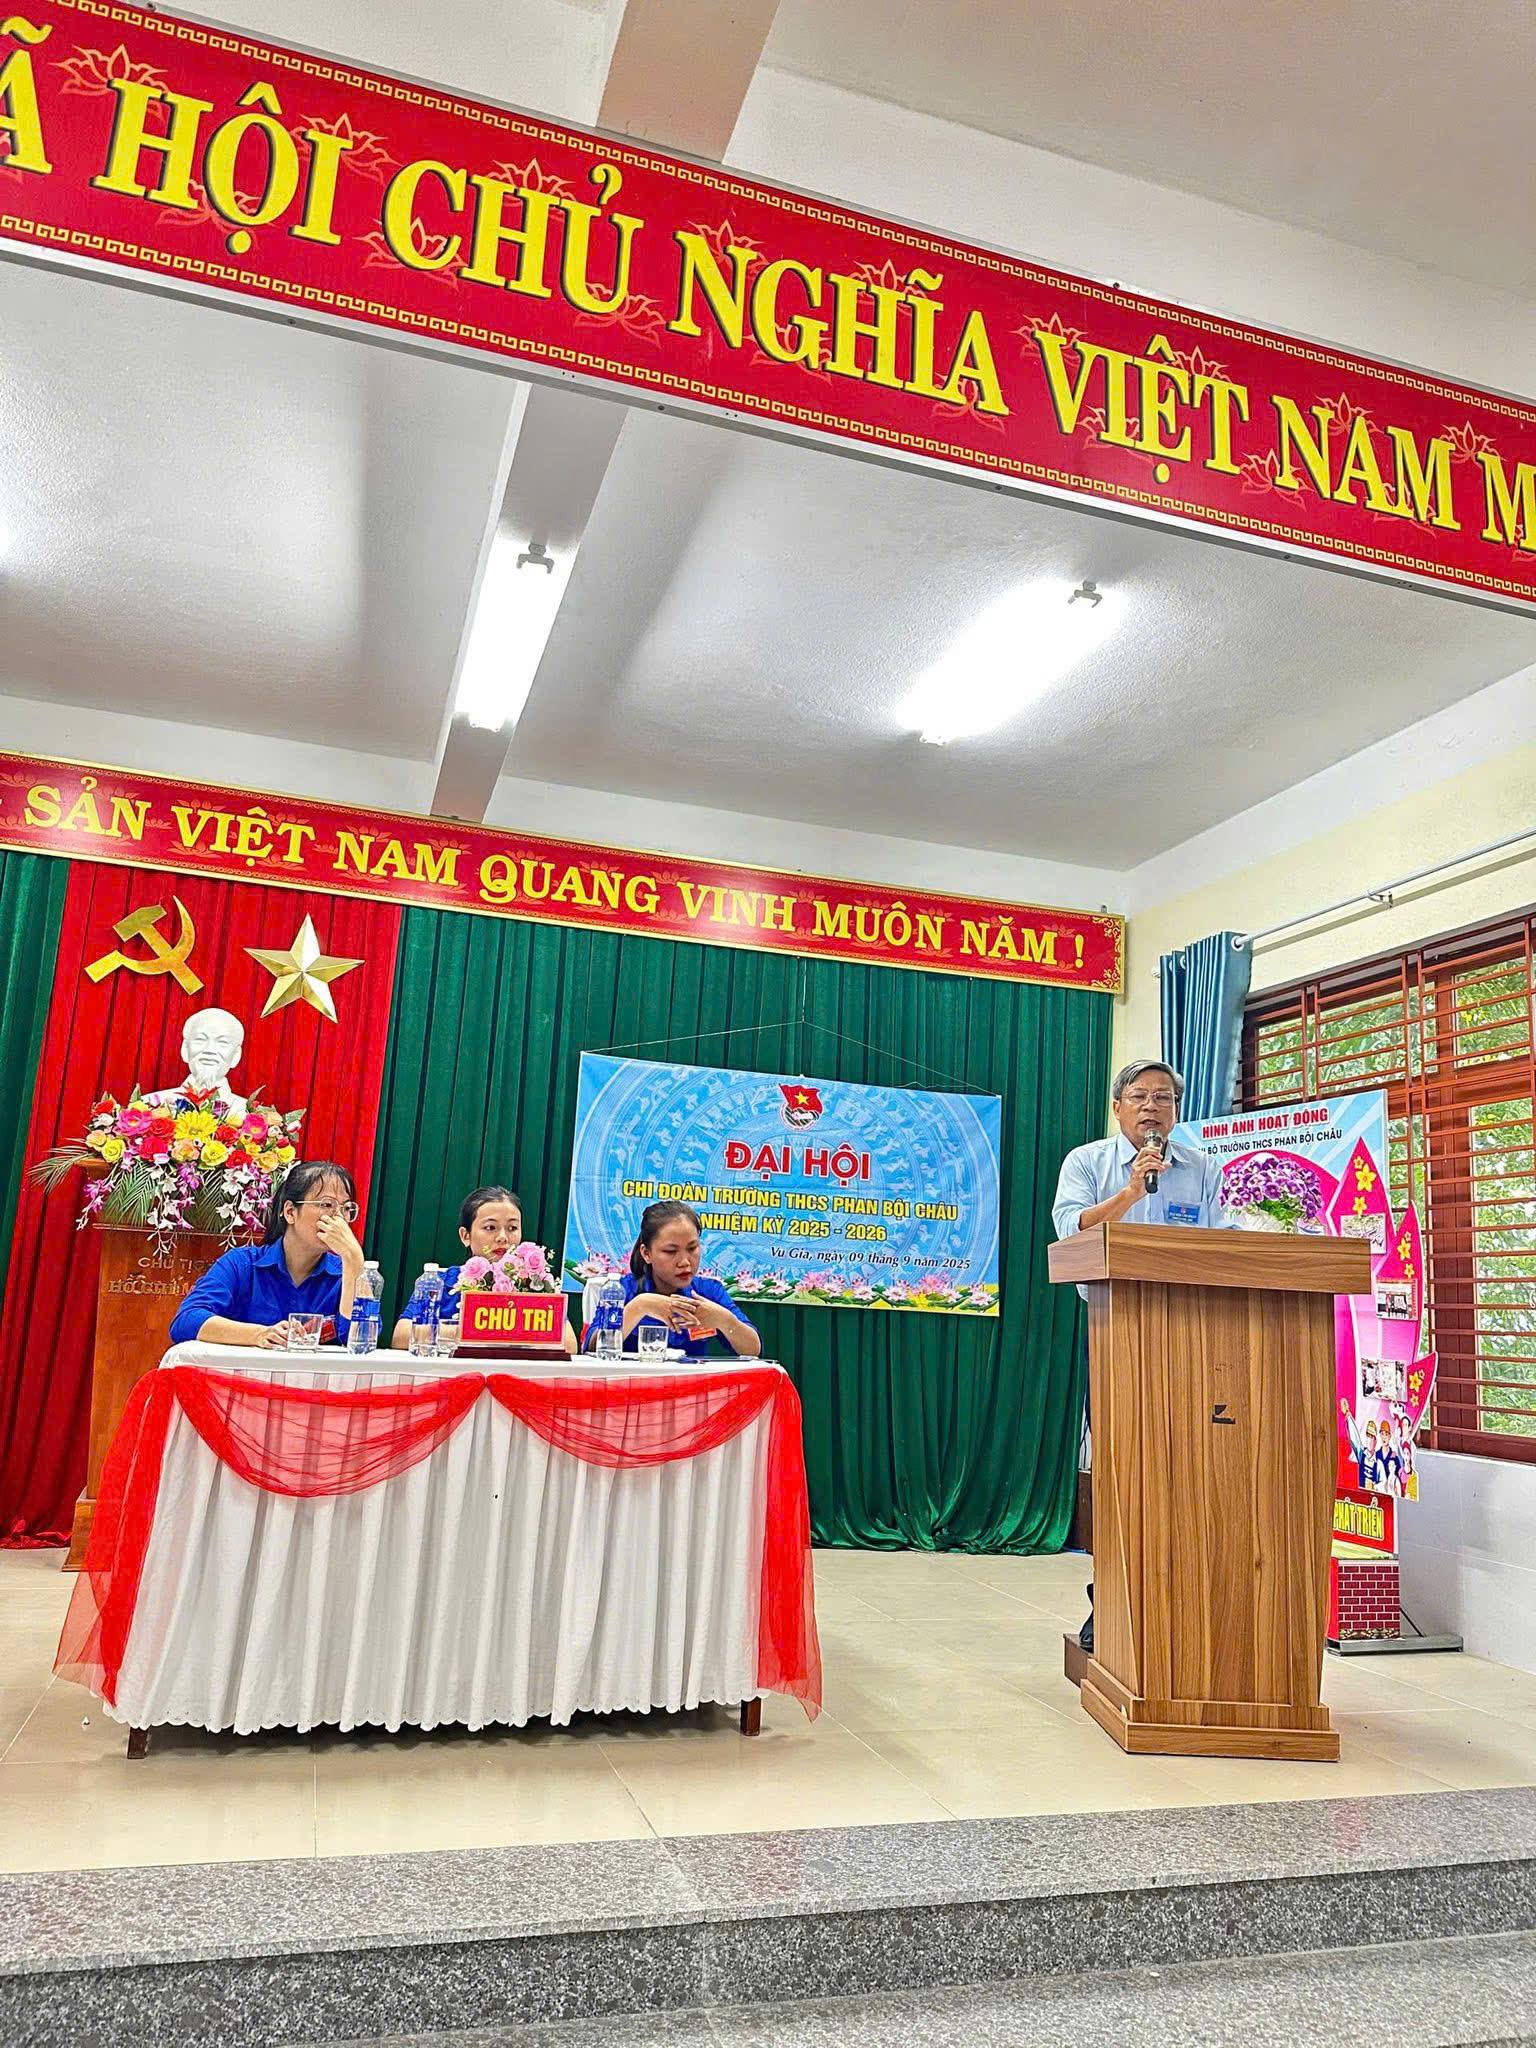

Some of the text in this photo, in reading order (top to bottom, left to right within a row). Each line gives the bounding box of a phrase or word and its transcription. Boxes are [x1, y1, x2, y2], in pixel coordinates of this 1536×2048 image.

[94, 79, 354, 255] HỘI
[384, 161, 644, 314] CHỦ
[668, 231, 1009, 415] NGHĨA
[1033, 330, 1250, 483] VIỆT
[1271, 395, 1461, 531] NAM
[23, 775, 1085, 968] SẢN VIỆT NAM QUANG VINH MUÔN NĂM !
[1258, 1114, 1289, 1131] HOẠT
[1293, 1107, 1328, 1127] ĐỘNG
[1220, 1141, 1250, 1153] TRƯỜNG
[1252, 1138, 1273, 1149] THCS
[1274, 1135, 1298, 1147] PHAN
[1299, 1131, 1314, 1146] BỘI
[1316, 1127, 1342, 1142] CHÂU
[725, 1140, 871, 1187] ĐẠI HỘI
[622, 1179, 958, 1221] CHI ĐOÀN TRƯỜNG THCS PHAN BỘI CHÂU
[699, 1211, 758, 1235] NHIỆM
[762, 1217, 785, 1235] KỲ
[787, 1219, 831, 1238] 2025
[845, 1223, 887, 1241] 2026
[788, 1247, 812, 1261] Gia,
[816, 1250, 845, 1264] ngày
[848, 1251, 864, 1262] 09
[867, 1252, 899, 1267] tháng
[903, 1255, 911, 1266] 9
[942, 1258, 971, 1269] 2025
[474, 1300, 554, 1332] CHỦ TRÌ
[1357, 1497, 1383, 1540] TRIỂN
